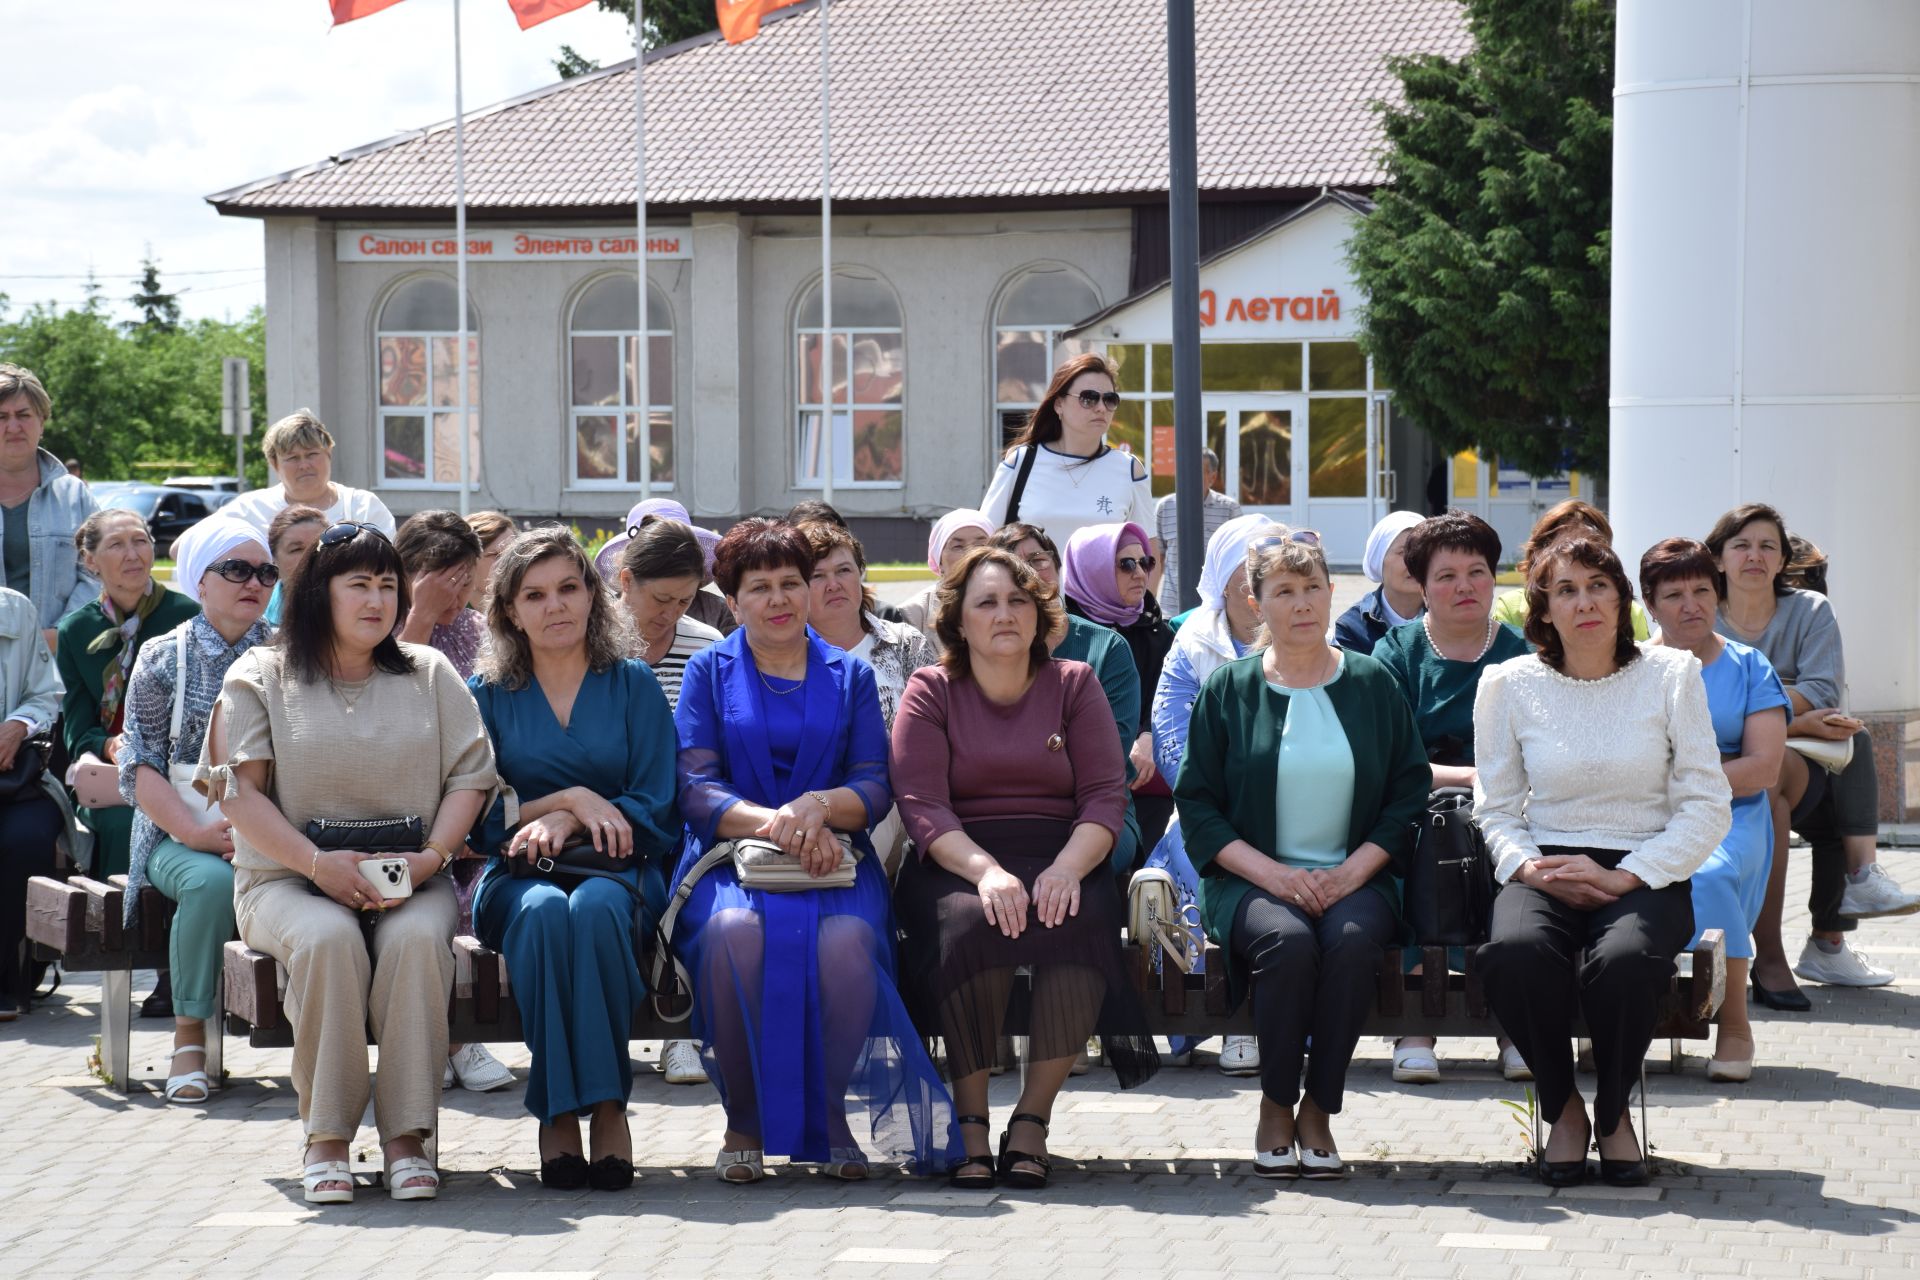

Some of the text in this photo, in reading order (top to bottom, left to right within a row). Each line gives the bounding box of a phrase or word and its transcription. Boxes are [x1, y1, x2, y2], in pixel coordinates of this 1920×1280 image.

[359, 234, 493, 255] Салон свзи
[514, 233, 593, 255] Элемтә
[1226, 289, 1339, 321] летай
